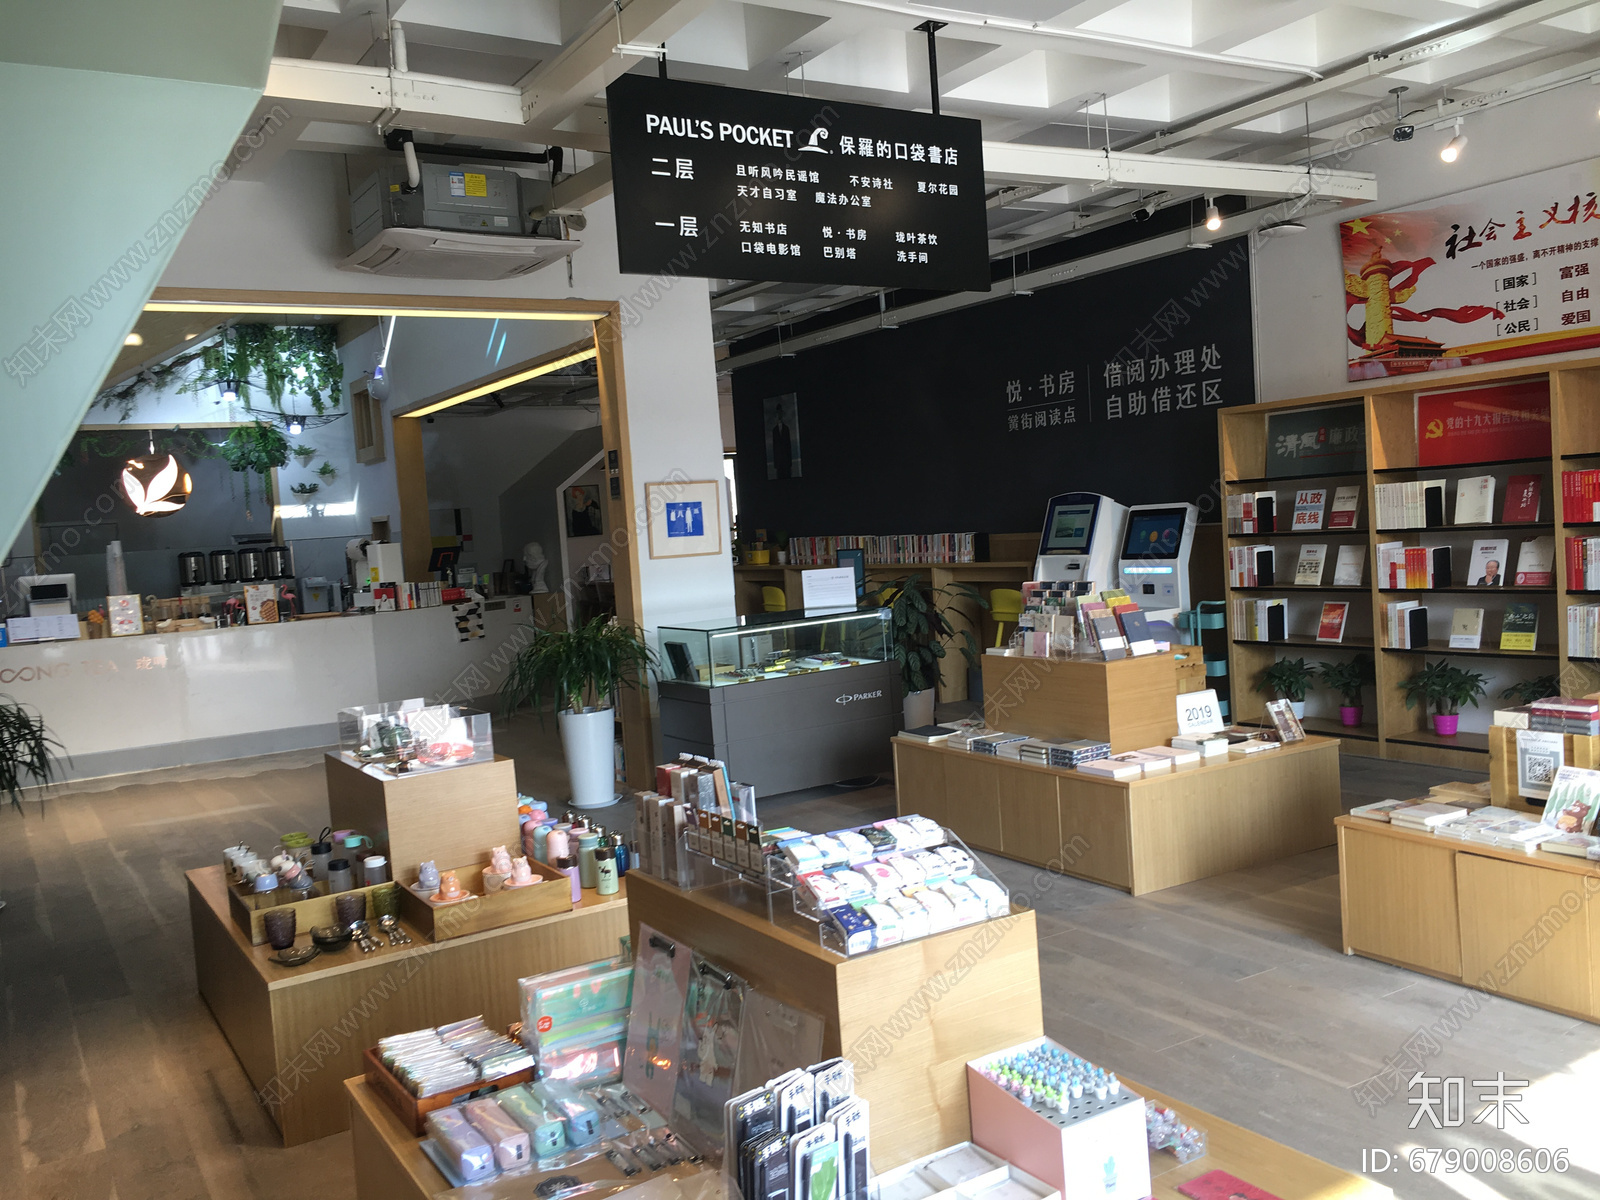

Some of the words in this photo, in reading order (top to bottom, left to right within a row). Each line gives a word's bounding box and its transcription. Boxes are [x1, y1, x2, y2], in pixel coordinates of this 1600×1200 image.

[646, 113, 714, 140] PAUL'S
[719, 123, 793, 149] POCKET
[839, 135, 959, 166] 保羅的口袋書店
[651, 157, 694, 180] 二层
[735, 164, 820, 184] 且听风吟民谣馆
[849, 175, 894, 191] 不安诗社
[917, 181, 959, 197] 夏尔花园
[737, 185, 798, 202] 天才自习室
[815, 191, 872, 208] 魔法办公室
[655, 215, 699, 237] 一层
[739, 221, 788, 236] 无知书店
[1445, 191, 1600, 259] 社会主义核
[895, 231, 938, 245] 珑叶茶饮
[741, 242, 801, 257] 口袋电影馆
[823, 246, 857, 260] 巴别塔
[896, 250, 929, 264] 洗手间
[1559, 263, 1590, 280] 富强
[1561, 287, 1590, 303] 自由
[1561, 310, 1591, 326] 爱国
[1103, 343, 1222, 389] 借阅办理处
[1106, 378, 1223, 420] 自助借还区
[1298, 492, 1323, 505] 从政
[1295, 512, 1319, 525] 底线
[853, 690, 883, 702] PARKER
[1185, 704, 1213, 722] 2019
